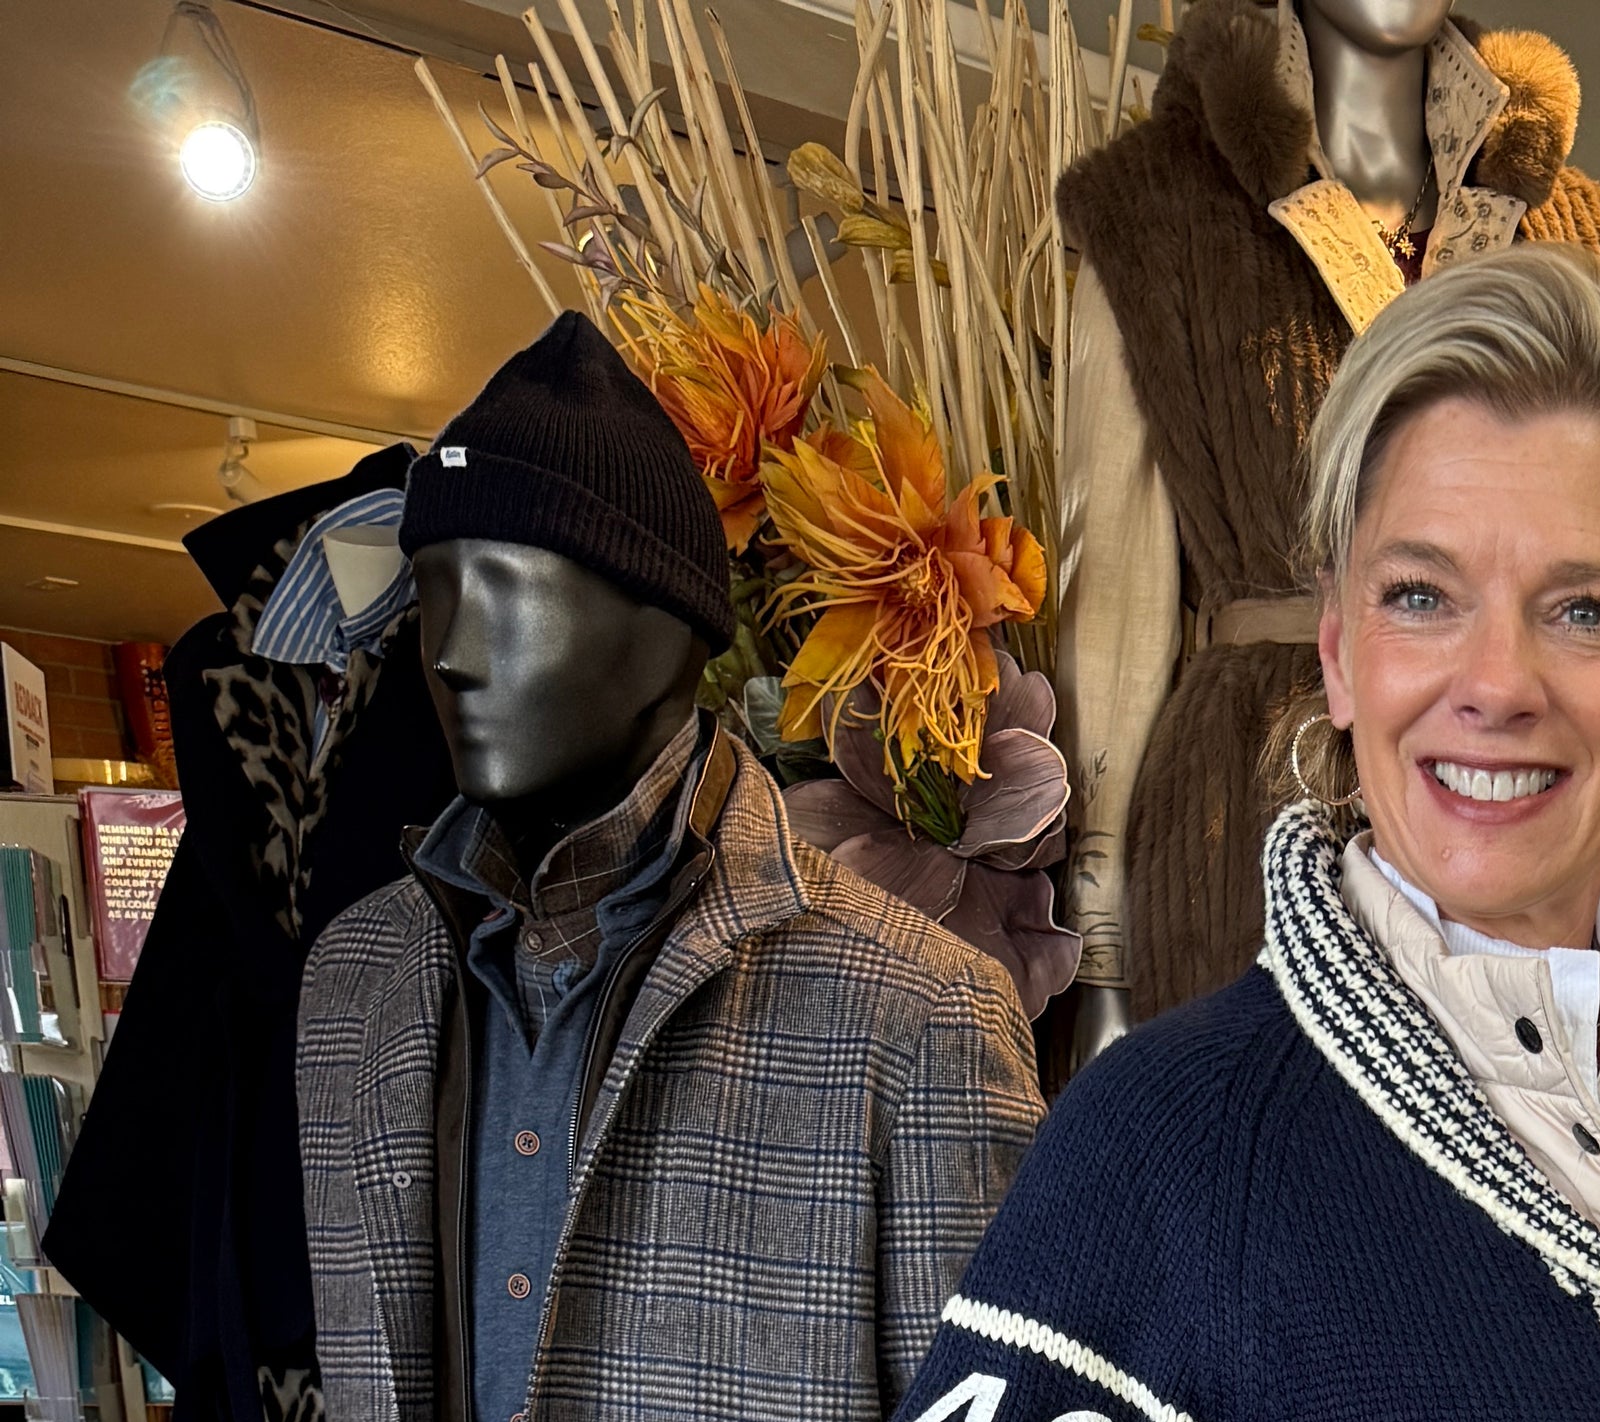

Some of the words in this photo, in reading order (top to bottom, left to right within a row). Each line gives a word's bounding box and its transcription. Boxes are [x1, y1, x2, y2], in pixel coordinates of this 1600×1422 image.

[98, 824, 153, 835] REMEMBER
[155, 827, 169, 836] AS
[100, 836, 129, 845] WHEN
[131, 837, 153, 847] YOU
[155, 838, 179, 848] FELL
[101, 846, 116, 855] ON
[119, 847, 127, 855] A
[102, 857, 123, 866] AND
[104, 868, 150, 878] JUMPING
[151, 869, 167, 879] SO
[104, 878, 156, 888] COULDN'T
[104, 889, 131, 898] BACK
[106, 900, 156, 910] WELCOME
[108, 910, 122, 919] AS
[124, 911, 138, 919] AN
